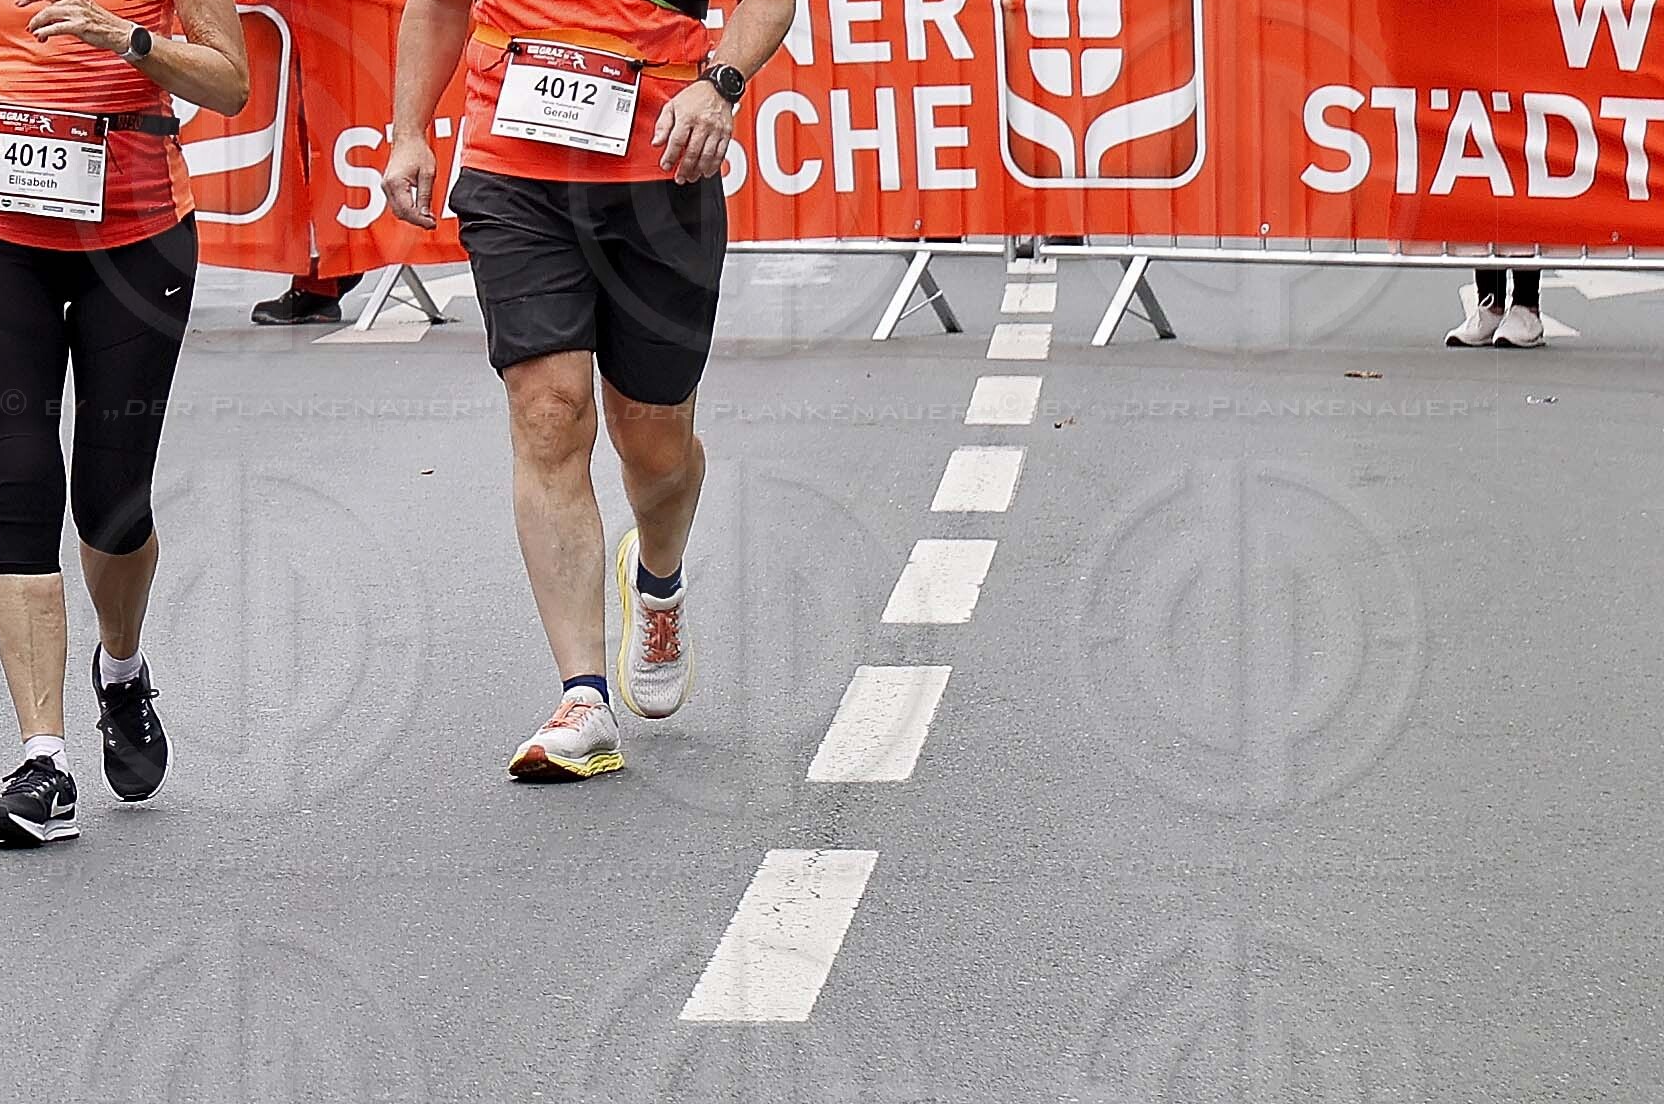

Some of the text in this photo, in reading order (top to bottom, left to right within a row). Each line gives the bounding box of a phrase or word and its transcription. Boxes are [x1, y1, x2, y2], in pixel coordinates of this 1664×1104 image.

[534, 75, 598, 106] 4012
[543, 105, 579, 121] Gerald
[4, 142, 68, 171] 4013
[8, 174, 59, 190] Elisabeth
